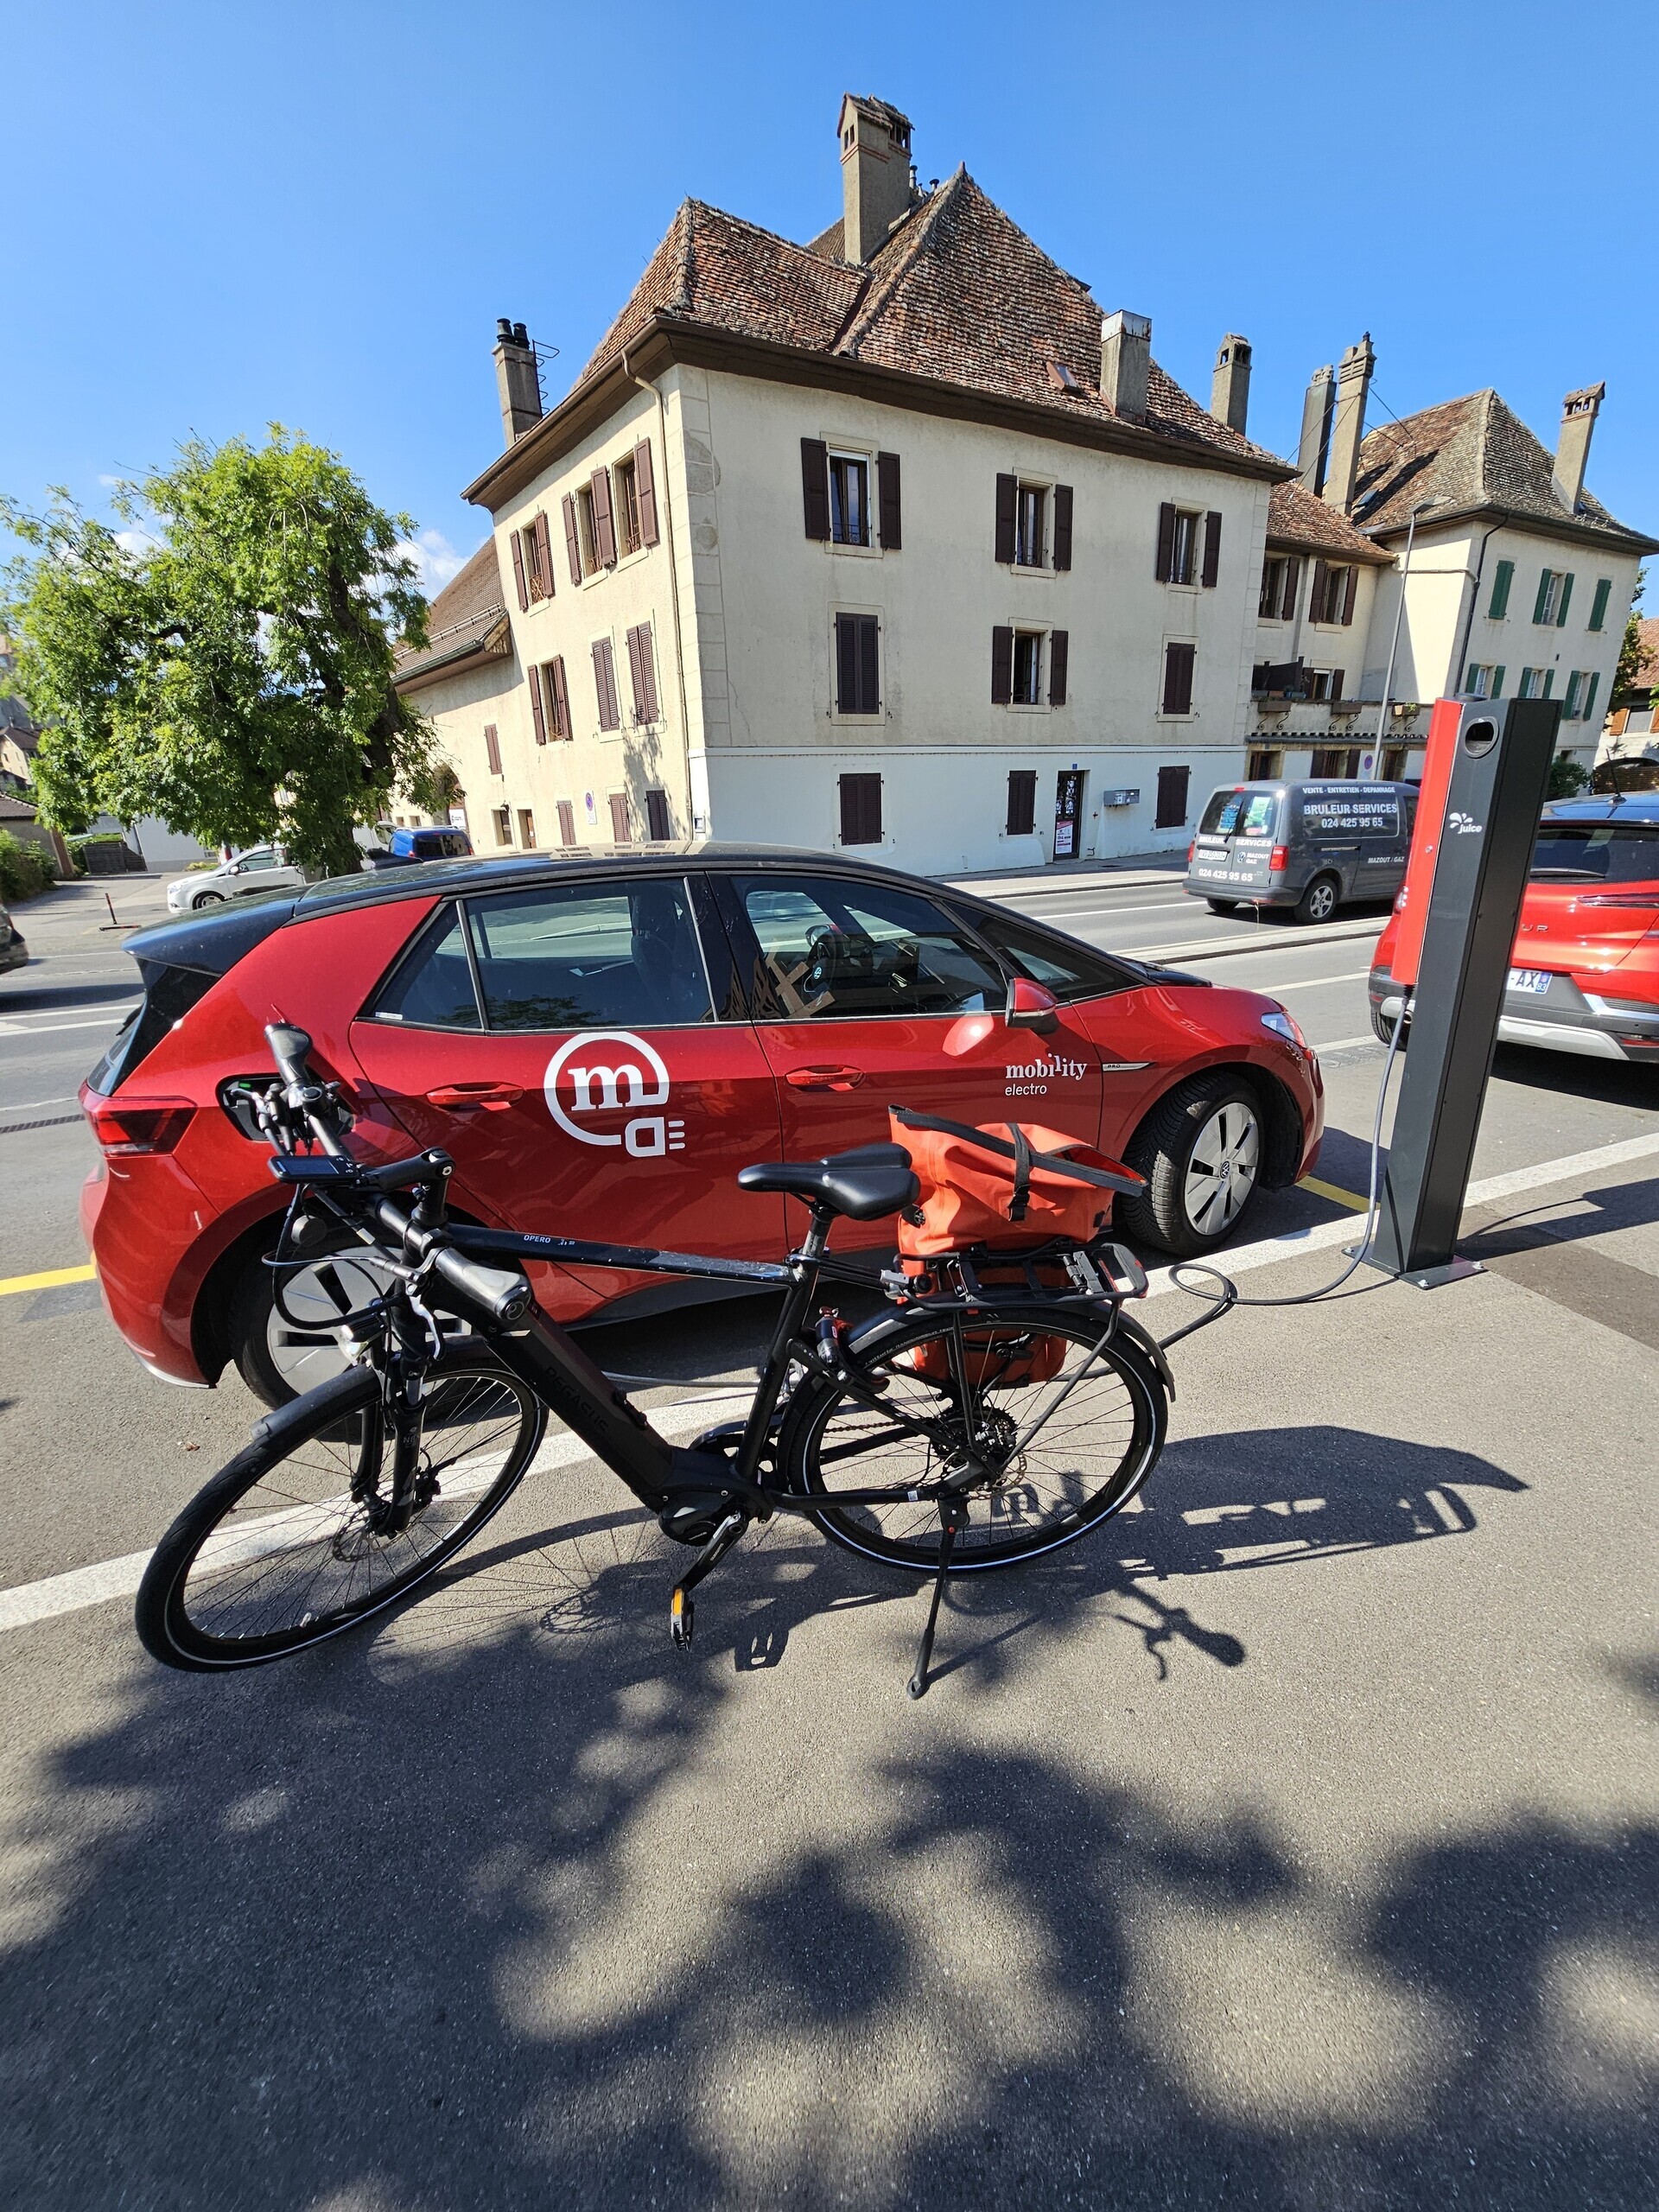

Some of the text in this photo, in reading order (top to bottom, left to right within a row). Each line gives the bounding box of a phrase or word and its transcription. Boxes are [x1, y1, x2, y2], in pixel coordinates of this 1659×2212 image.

[1303, 804, 1398, 815] BRULEUR SERVICES
[1321, 817, 1383, 829] 024 425 95 65
[1457, 823, 1483, 835] juice
[1236, 838, 1272, 847] SERVICES
[1198, 868, 1211, 877] 024
[1212, 869, 1227, 879] 425
[1229, 871, 1240, 880] 95
[1241, 873, 1253, 881] 65
[1005, 1052, 1088, 1081] mobility
[1005, 1084, 1047, 1096] electro
[524, 1235, 551, 1244] OPERO
